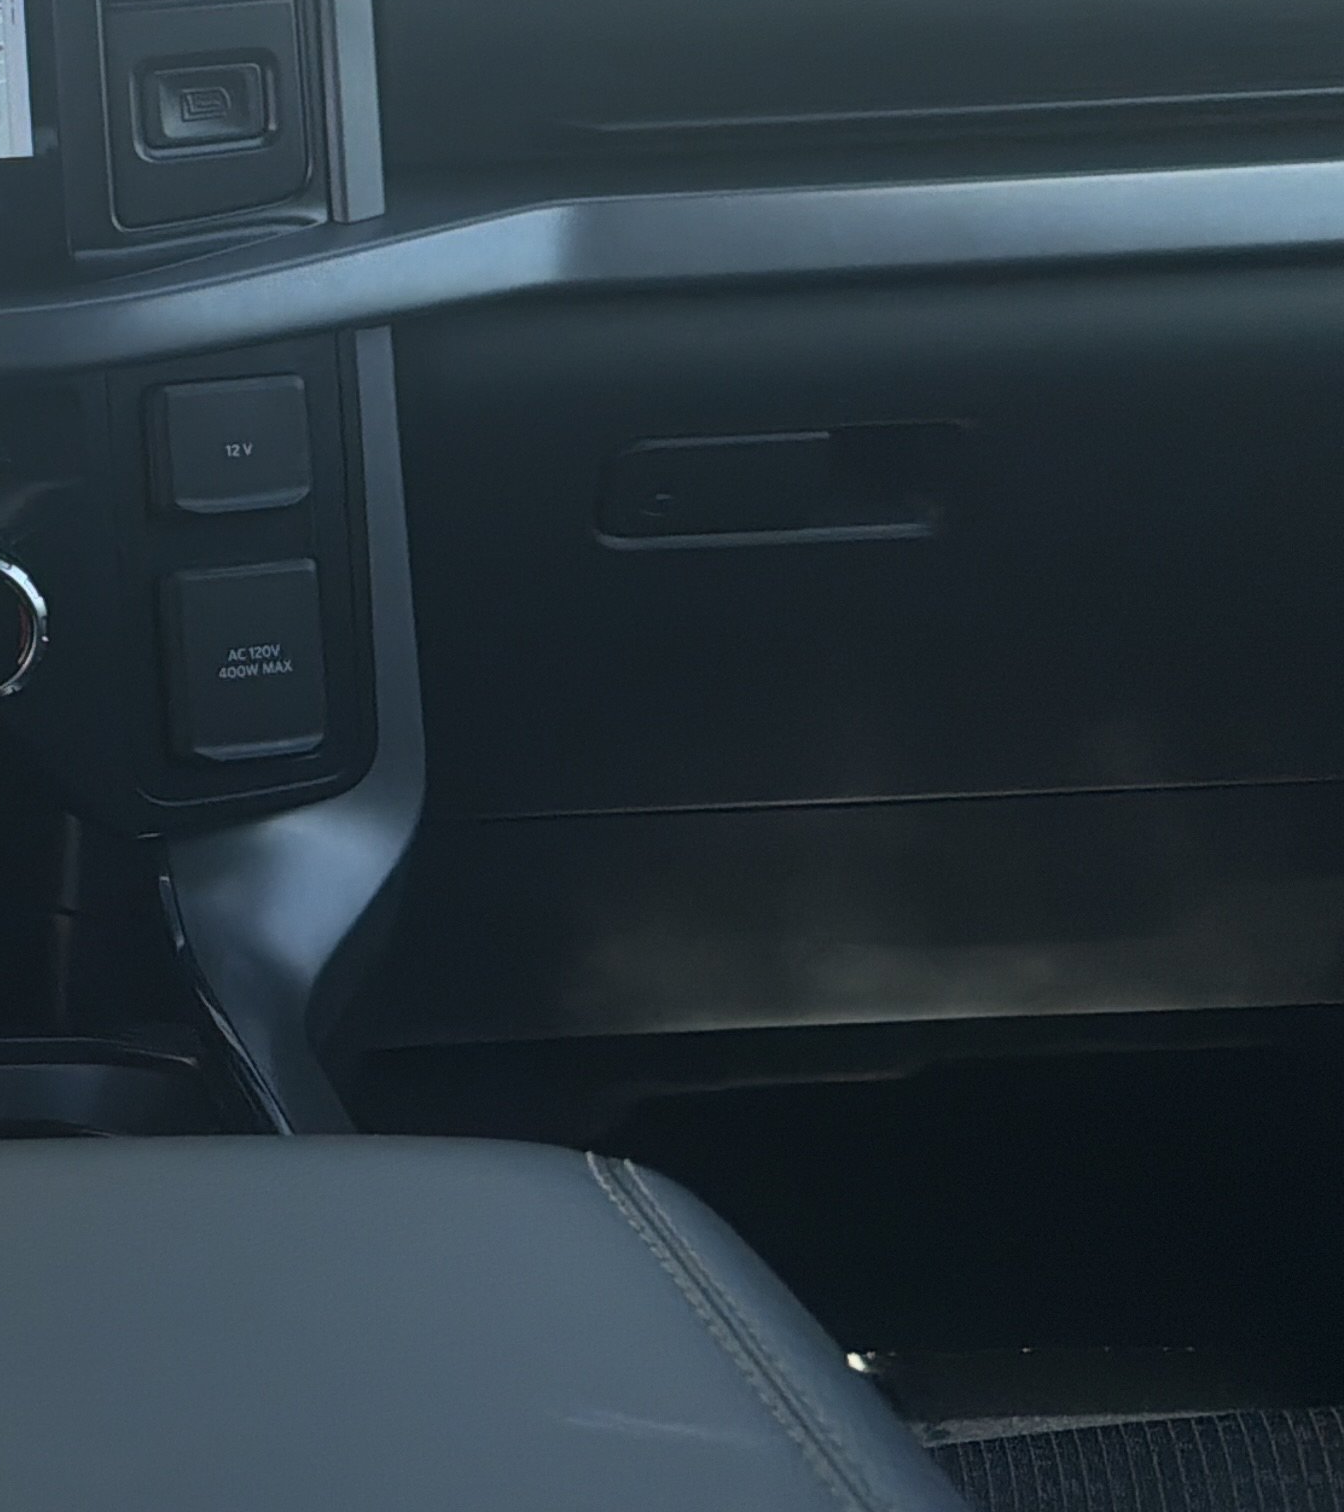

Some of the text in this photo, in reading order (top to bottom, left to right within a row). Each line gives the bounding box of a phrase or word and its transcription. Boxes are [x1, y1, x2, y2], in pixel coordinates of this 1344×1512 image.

[225, 443, 254, 457] 12 V
[228, 644, 281, 661] AC 120V
[219, 659, 292, 679] 400W MAX
